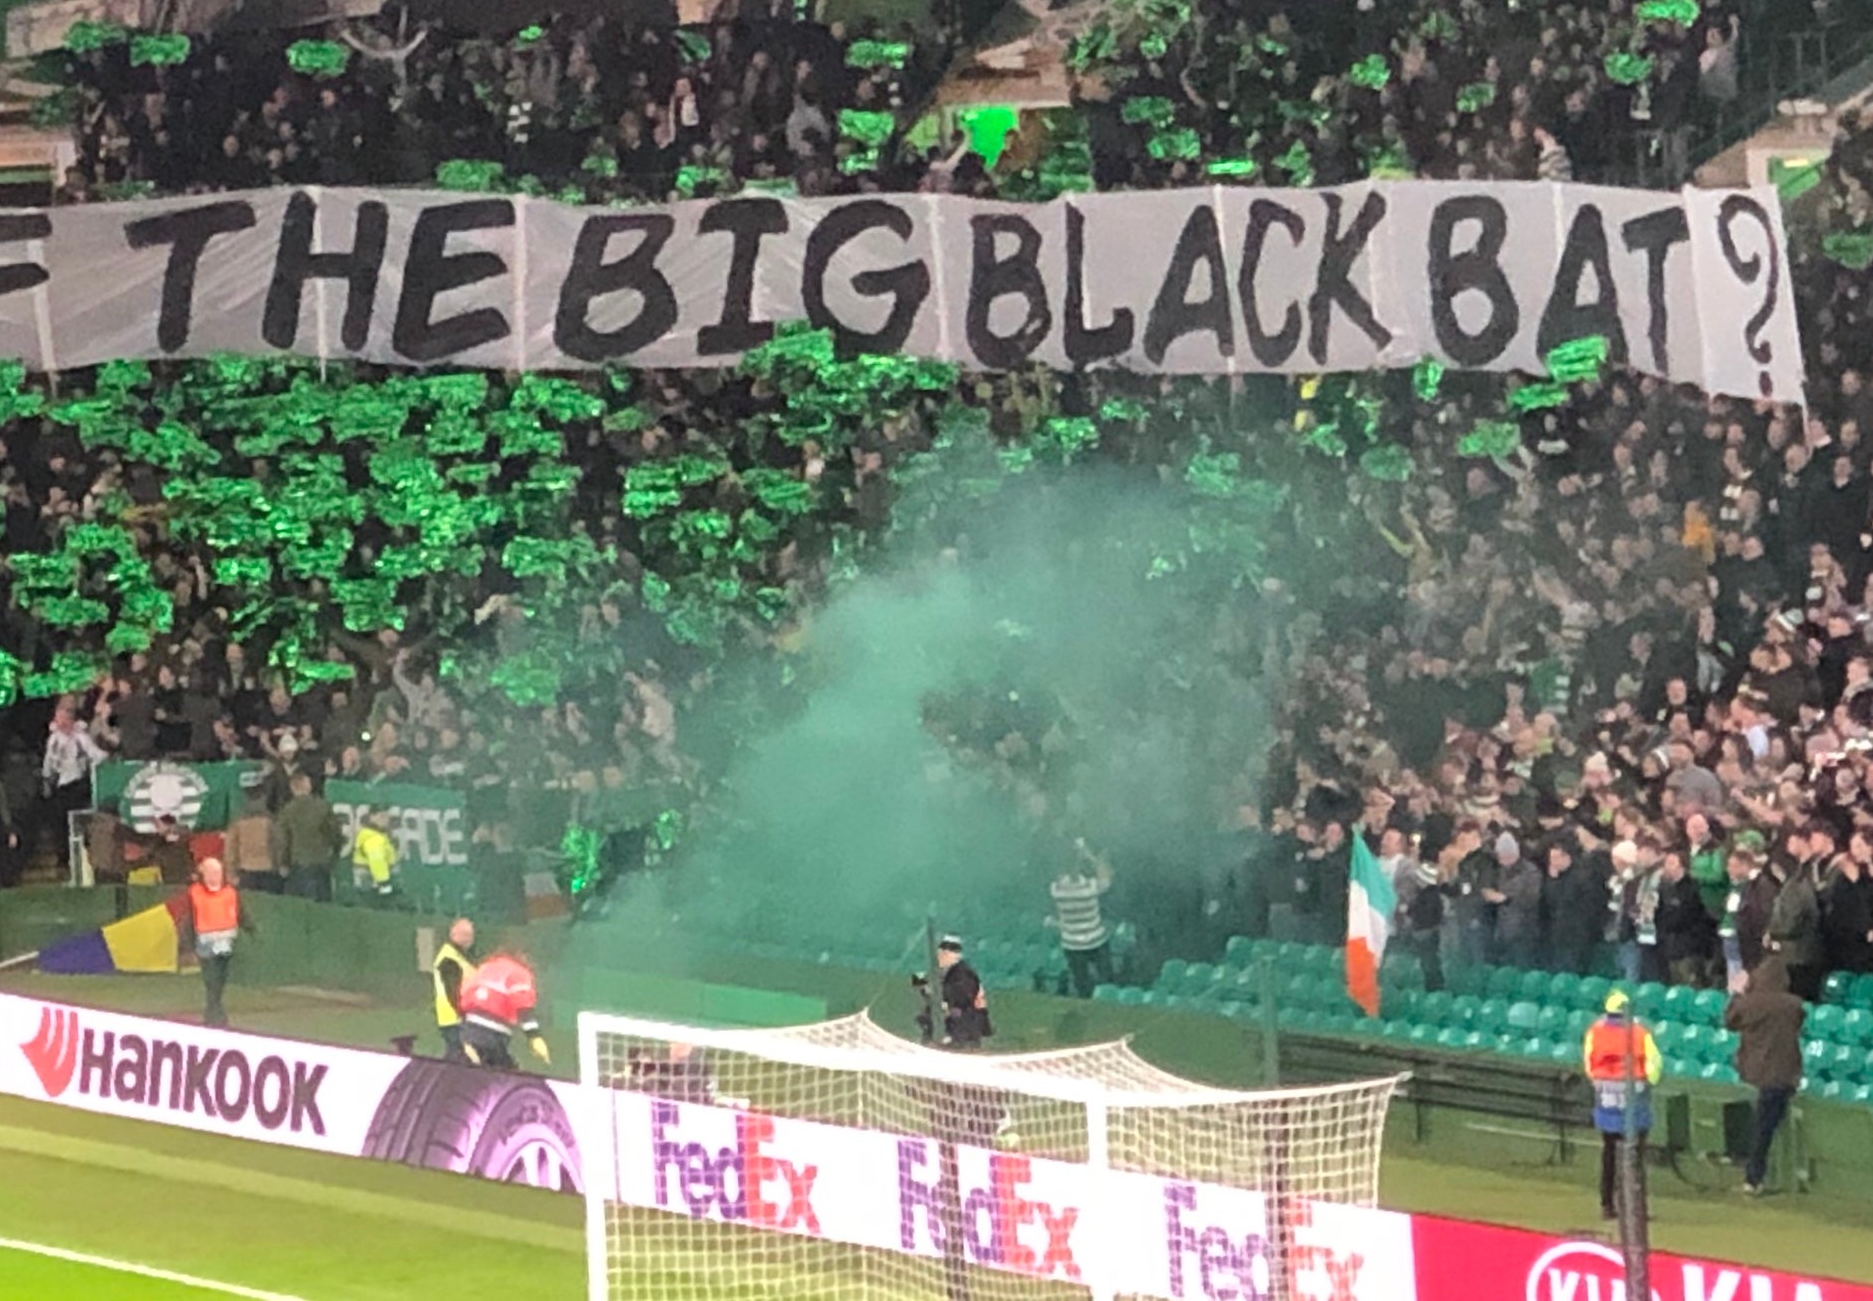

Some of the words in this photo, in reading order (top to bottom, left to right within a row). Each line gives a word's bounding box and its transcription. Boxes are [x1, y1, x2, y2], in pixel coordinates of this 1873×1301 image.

[127, 191, 518, 363] THE
[554, 198, 930, 362] BIG
[967, 189, 1397, 371] BLACK
[650, 1100, 821, 1234] FedEx
